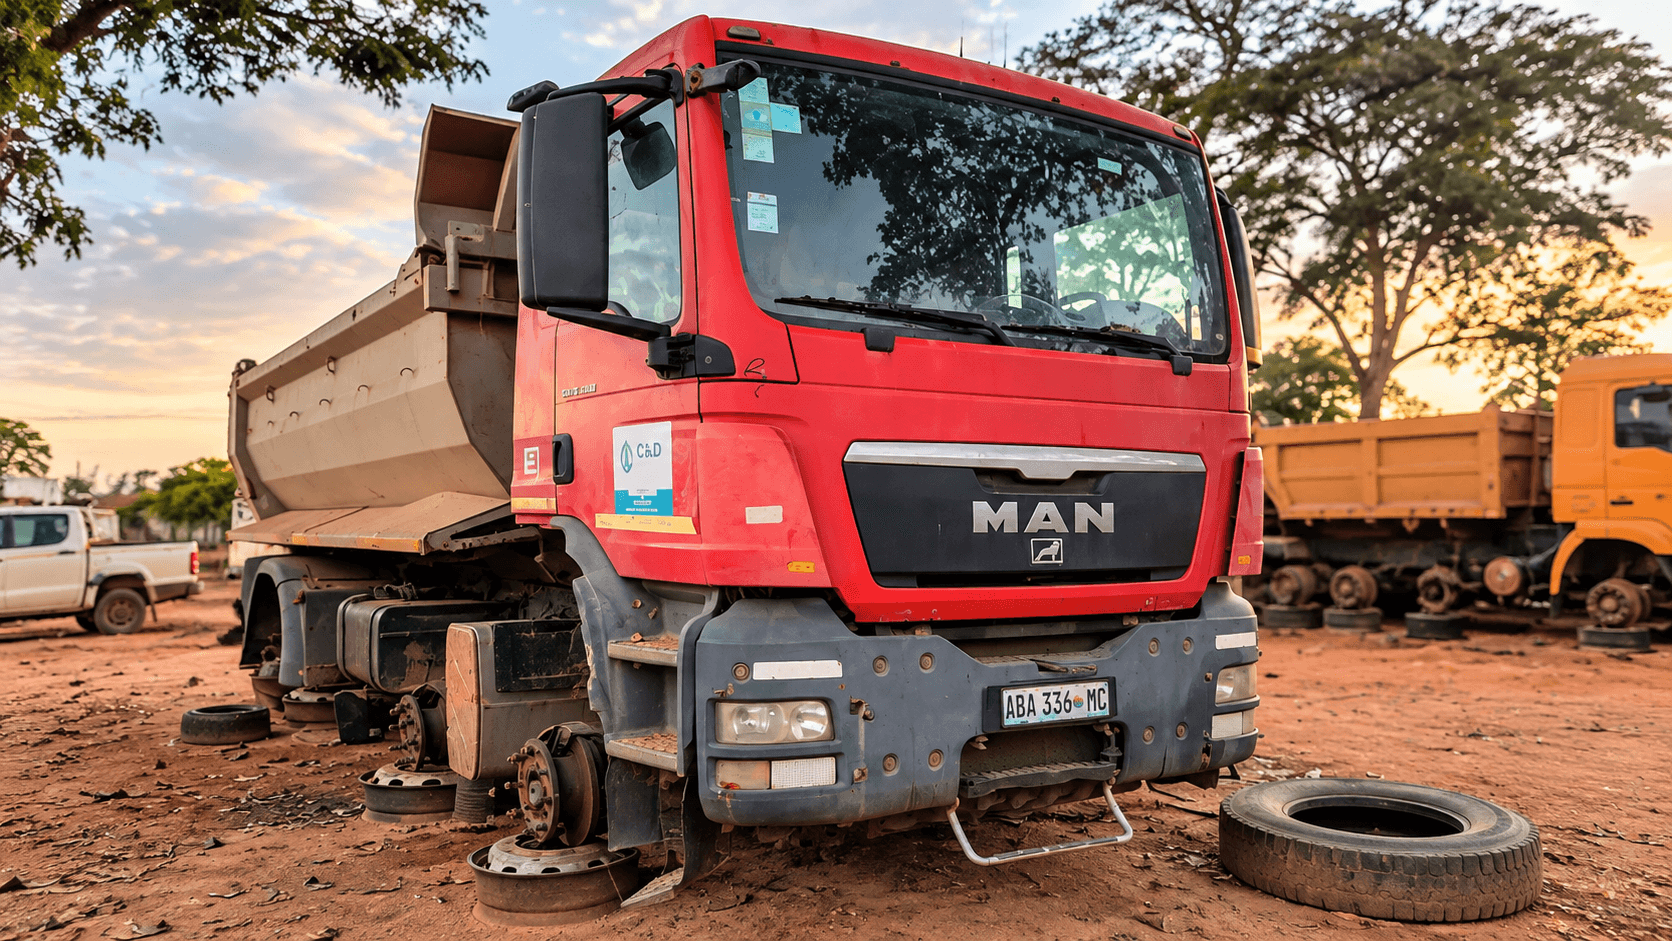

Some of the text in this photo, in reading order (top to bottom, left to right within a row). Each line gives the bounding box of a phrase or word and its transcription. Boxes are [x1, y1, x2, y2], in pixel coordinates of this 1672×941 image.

[972, 501, 1115, 534] MAN
[1005, 687, 1107, 719] ABA 336 MC
